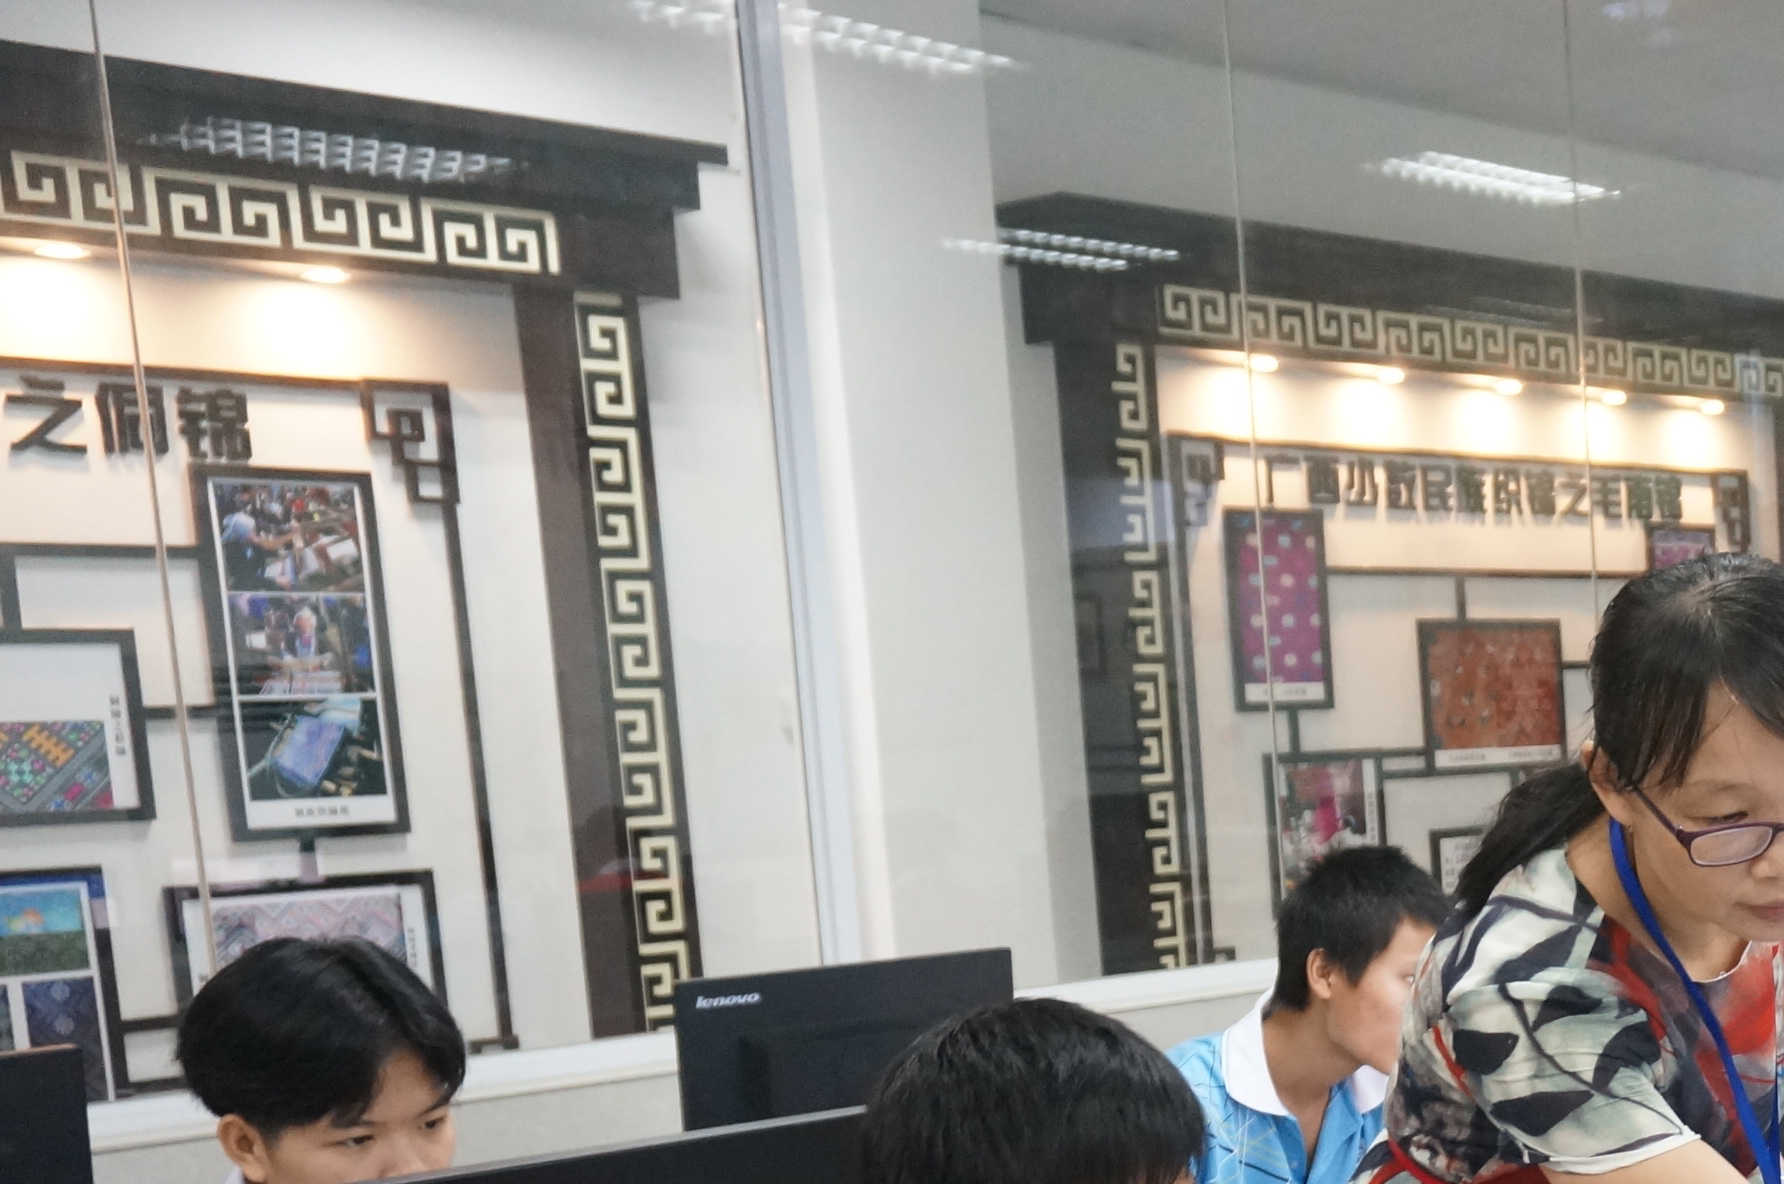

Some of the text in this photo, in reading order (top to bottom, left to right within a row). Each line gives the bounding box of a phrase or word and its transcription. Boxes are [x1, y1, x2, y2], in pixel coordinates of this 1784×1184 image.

[4, 374, 253, 462] 之侗锦
[695, 992, 761, 1009] lenovo
